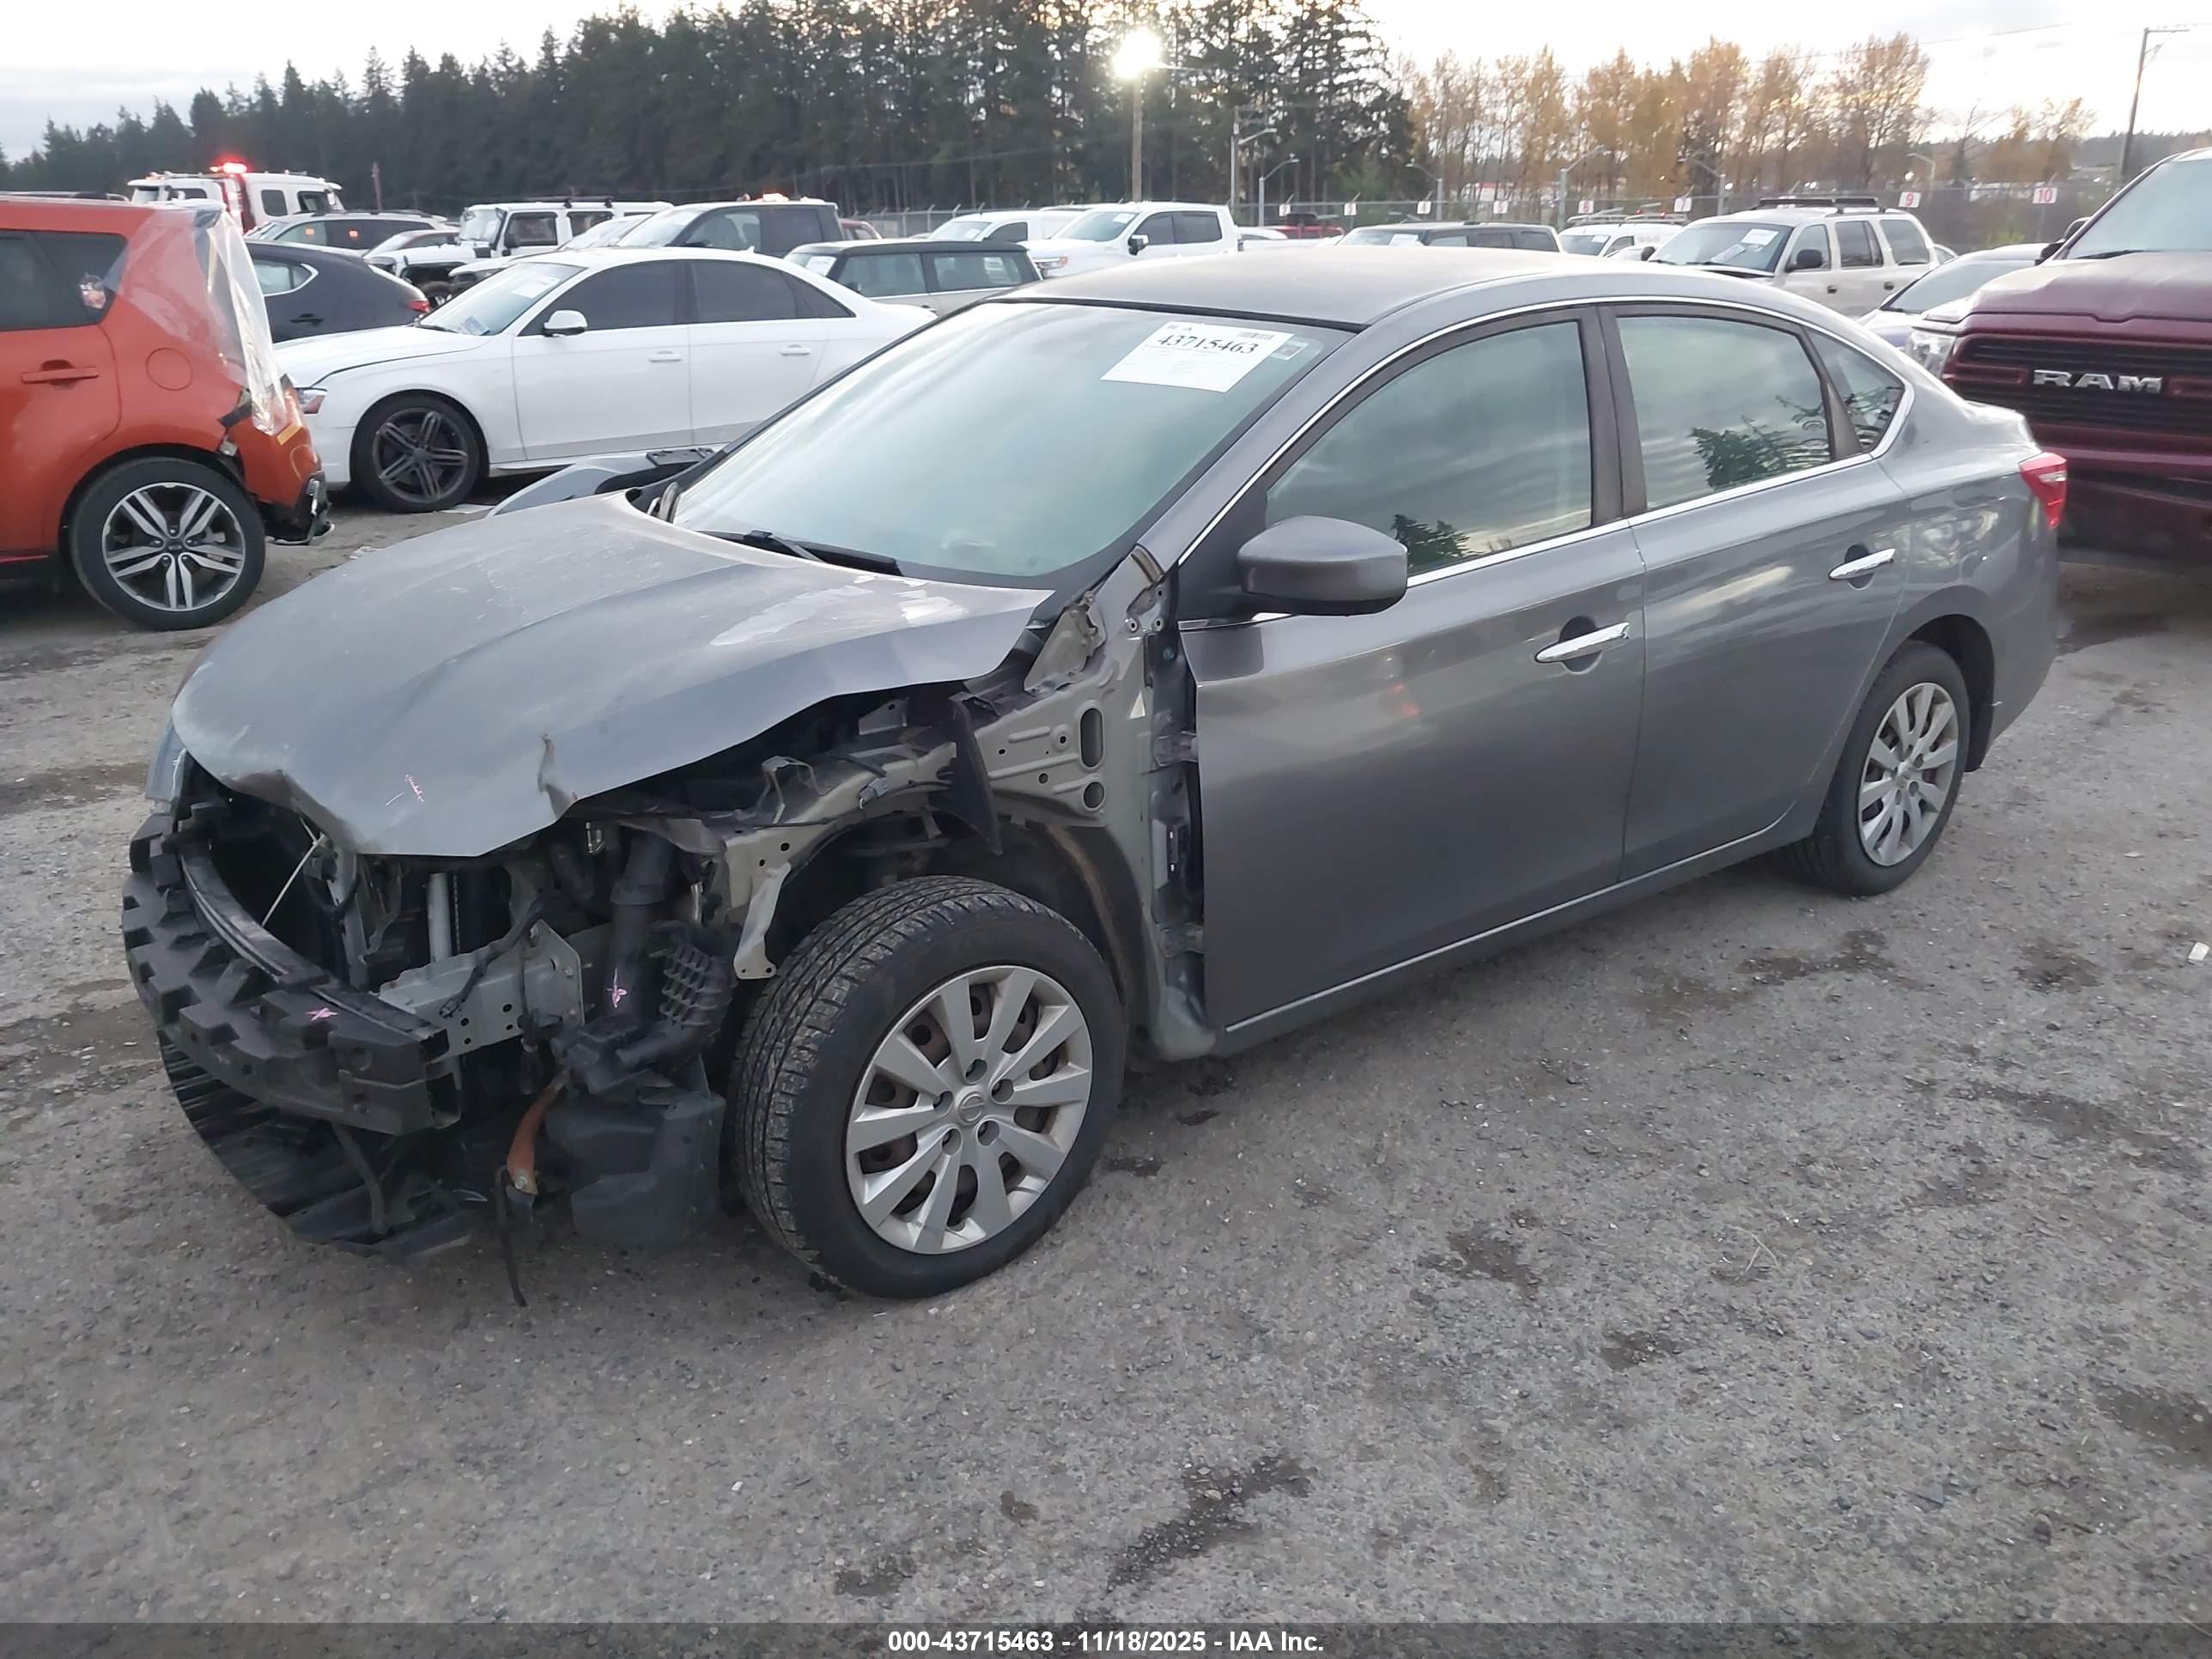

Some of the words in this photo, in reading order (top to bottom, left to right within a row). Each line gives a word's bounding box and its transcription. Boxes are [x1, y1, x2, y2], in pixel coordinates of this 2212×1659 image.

[1905, 193, 1913, 206] 9
[2038, 189, 2052, 203] 10
[1158, 334, 1260, 354] 43715463
[2033, 369, 2163, 393] RAM
